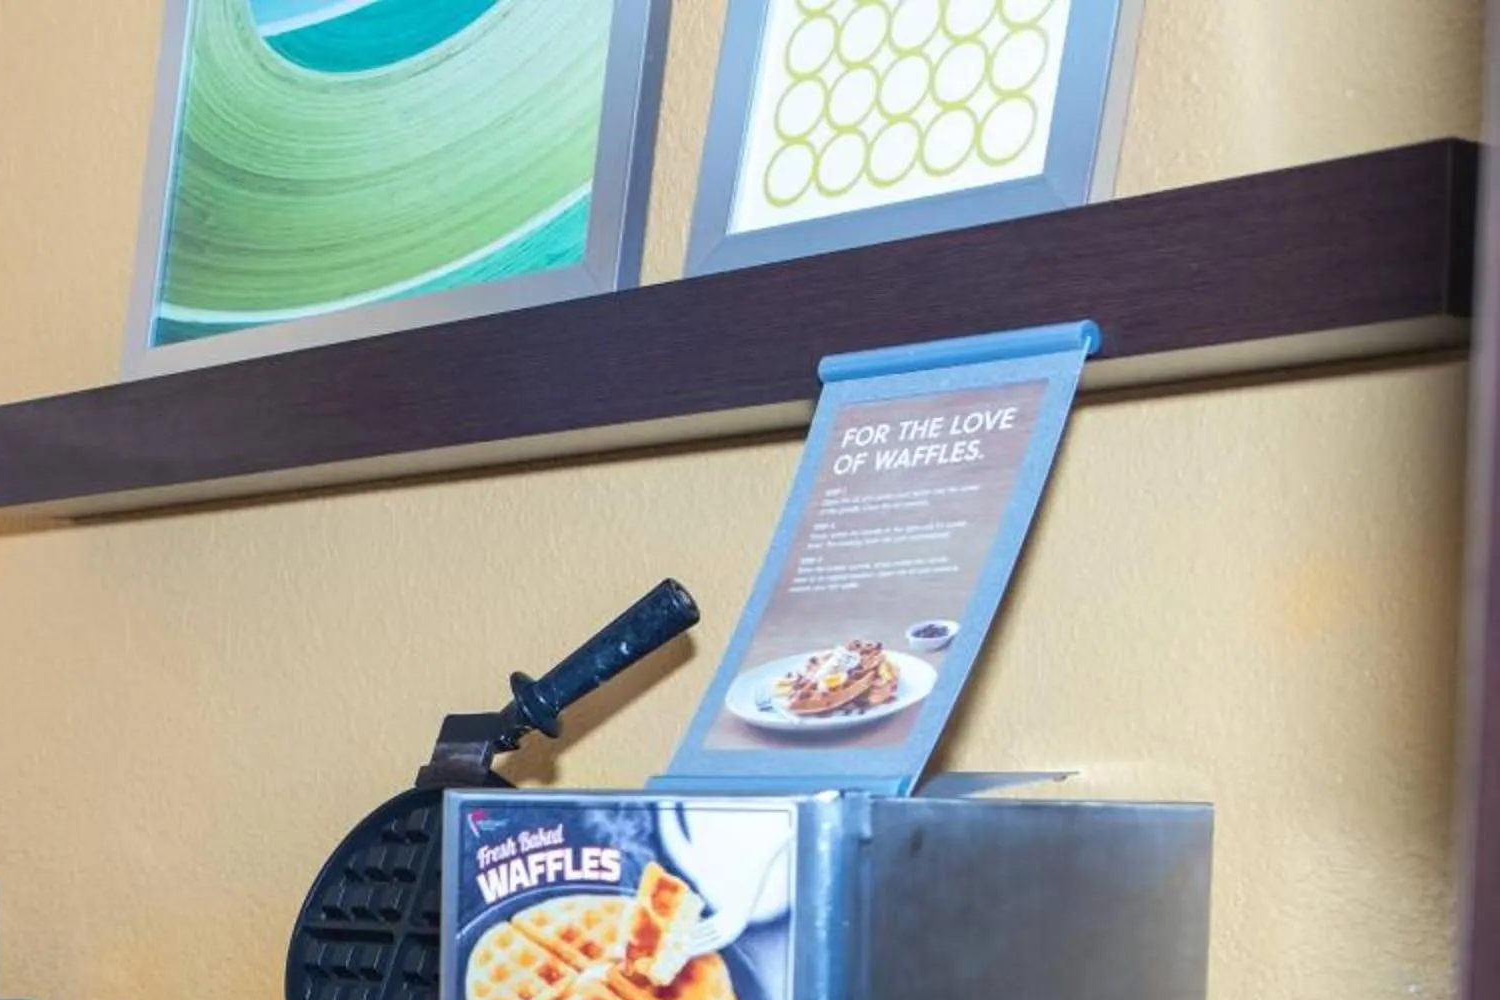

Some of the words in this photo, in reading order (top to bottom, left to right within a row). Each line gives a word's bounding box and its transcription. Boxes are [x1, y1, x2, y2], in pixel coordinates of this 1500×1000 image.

[842, 424, 890, 448] FOR
[899, 417, 944, 441] THE
[949, 407, 1018, 435] LOVE
[833, 454, 865, 476] OF
[875, 439, 985, 472] WAFFLES.
[476, 837, 517, 869] Fresh
[518, 823, 565, 852] Baked
[476, 847, 621, 905] WAFFLES
